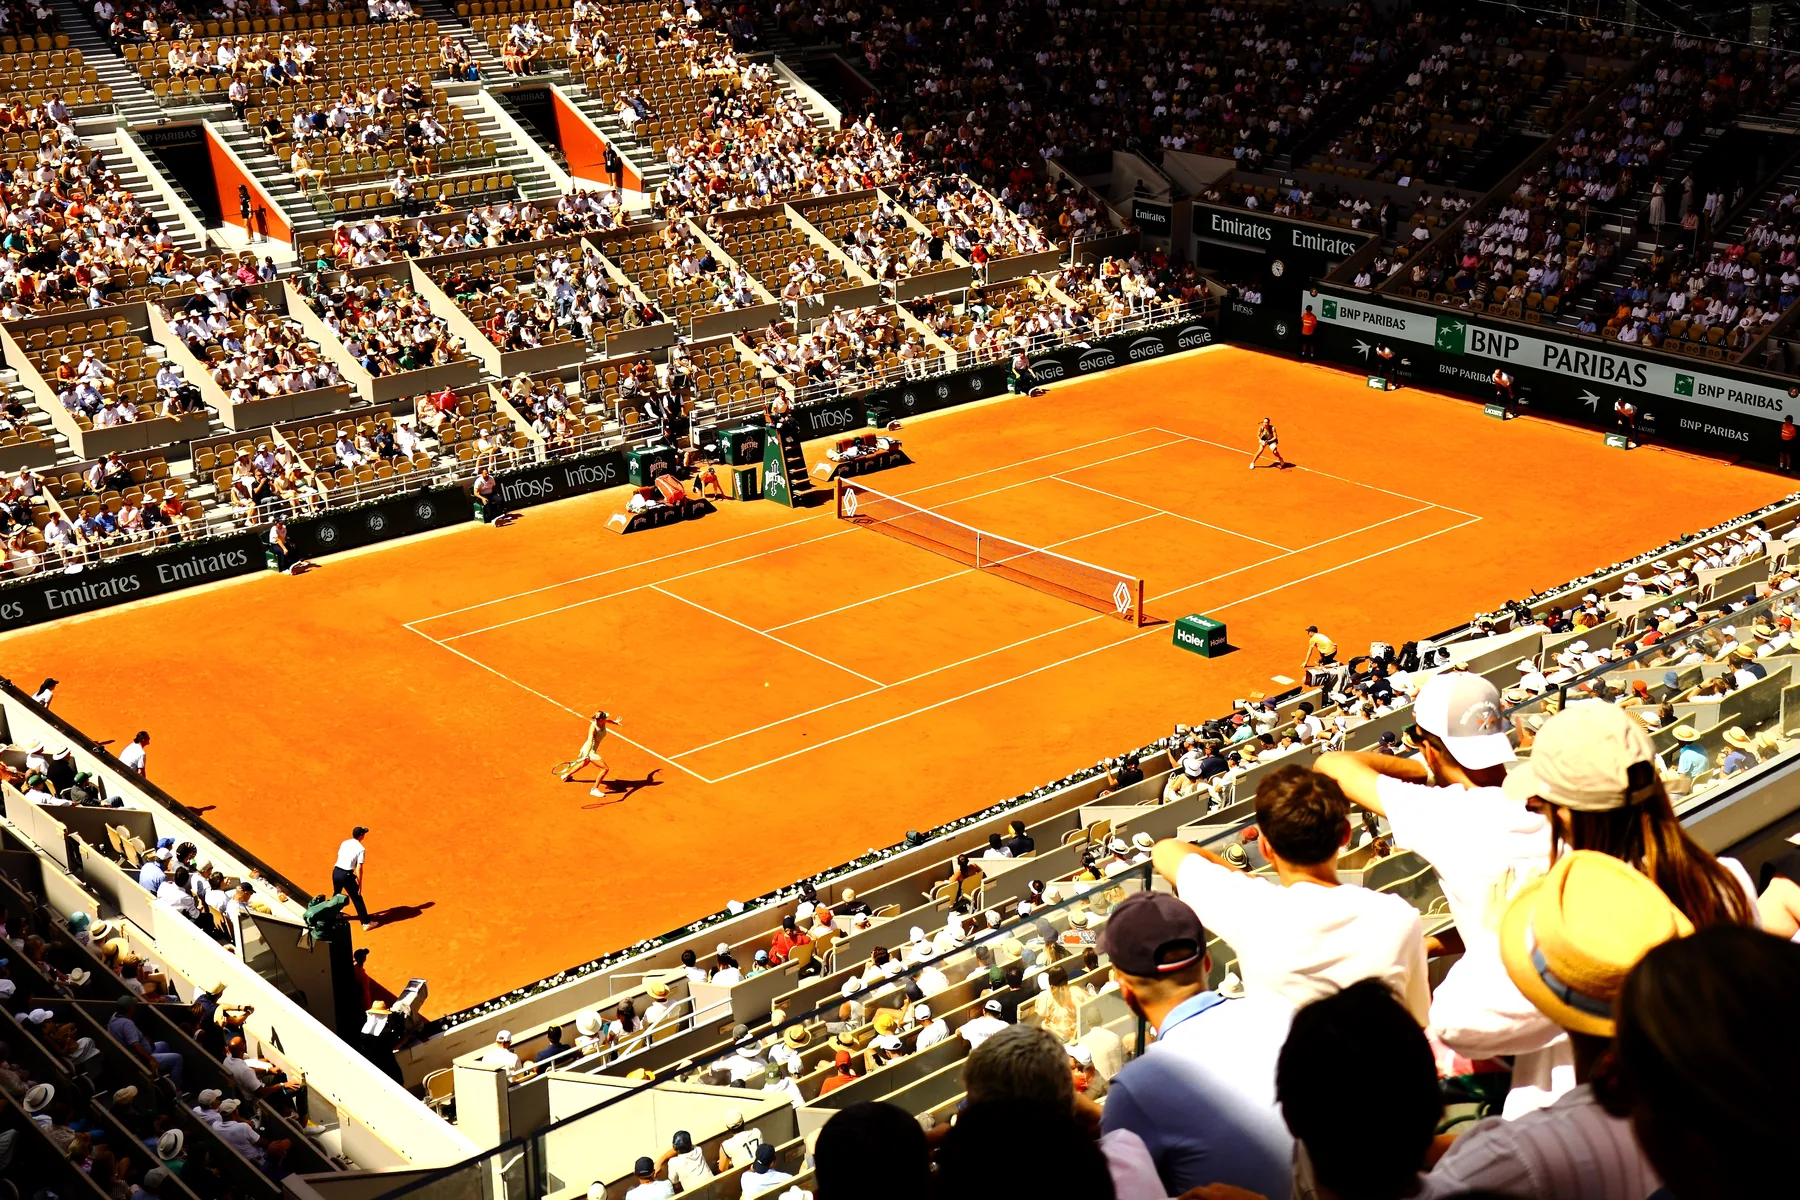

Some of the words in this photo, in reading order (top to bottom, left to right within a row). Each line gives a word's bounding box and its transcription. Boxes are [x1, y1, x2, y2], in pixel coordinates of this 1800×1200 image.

[511, 92, 545, 102] PARIBAS
[155, 130, 197, 142] PARIBAS
[1135, 208, 1166, 223] Emirates
[1211, 213, 1272, 241] Emirates
[1292, 229, 1356, 256] Emirates
[1232, 302, 1254, 315] Infosys
[1340, 306, 1361, 320] BNP
[1363, 312, 1406, 330] PARIBAS
[1439, 364, 1458, 375] BNP
[1471, 329, 1519, 358] BNP
[1543, 344, 1648, 388] PARIBAS
[1698, 383, 1725, 398] BNP
[1727, 389, 1783, 412] PARIBAS
[809, 407, 854, 430] Infosys
[1680, 418, 1702, 431] BNP
[1704, 424, 1750, 442] PARIBAS
[564, 462, 616, 487] Infosys
[500, 476, 554, 503] Infosys
[156, 549, 248, 584] Emirates
[44, 574, 141, 611] Emirates
[1177, 629, 1205, 647] Haier
[1209, 636, 1226, 647] Haier
